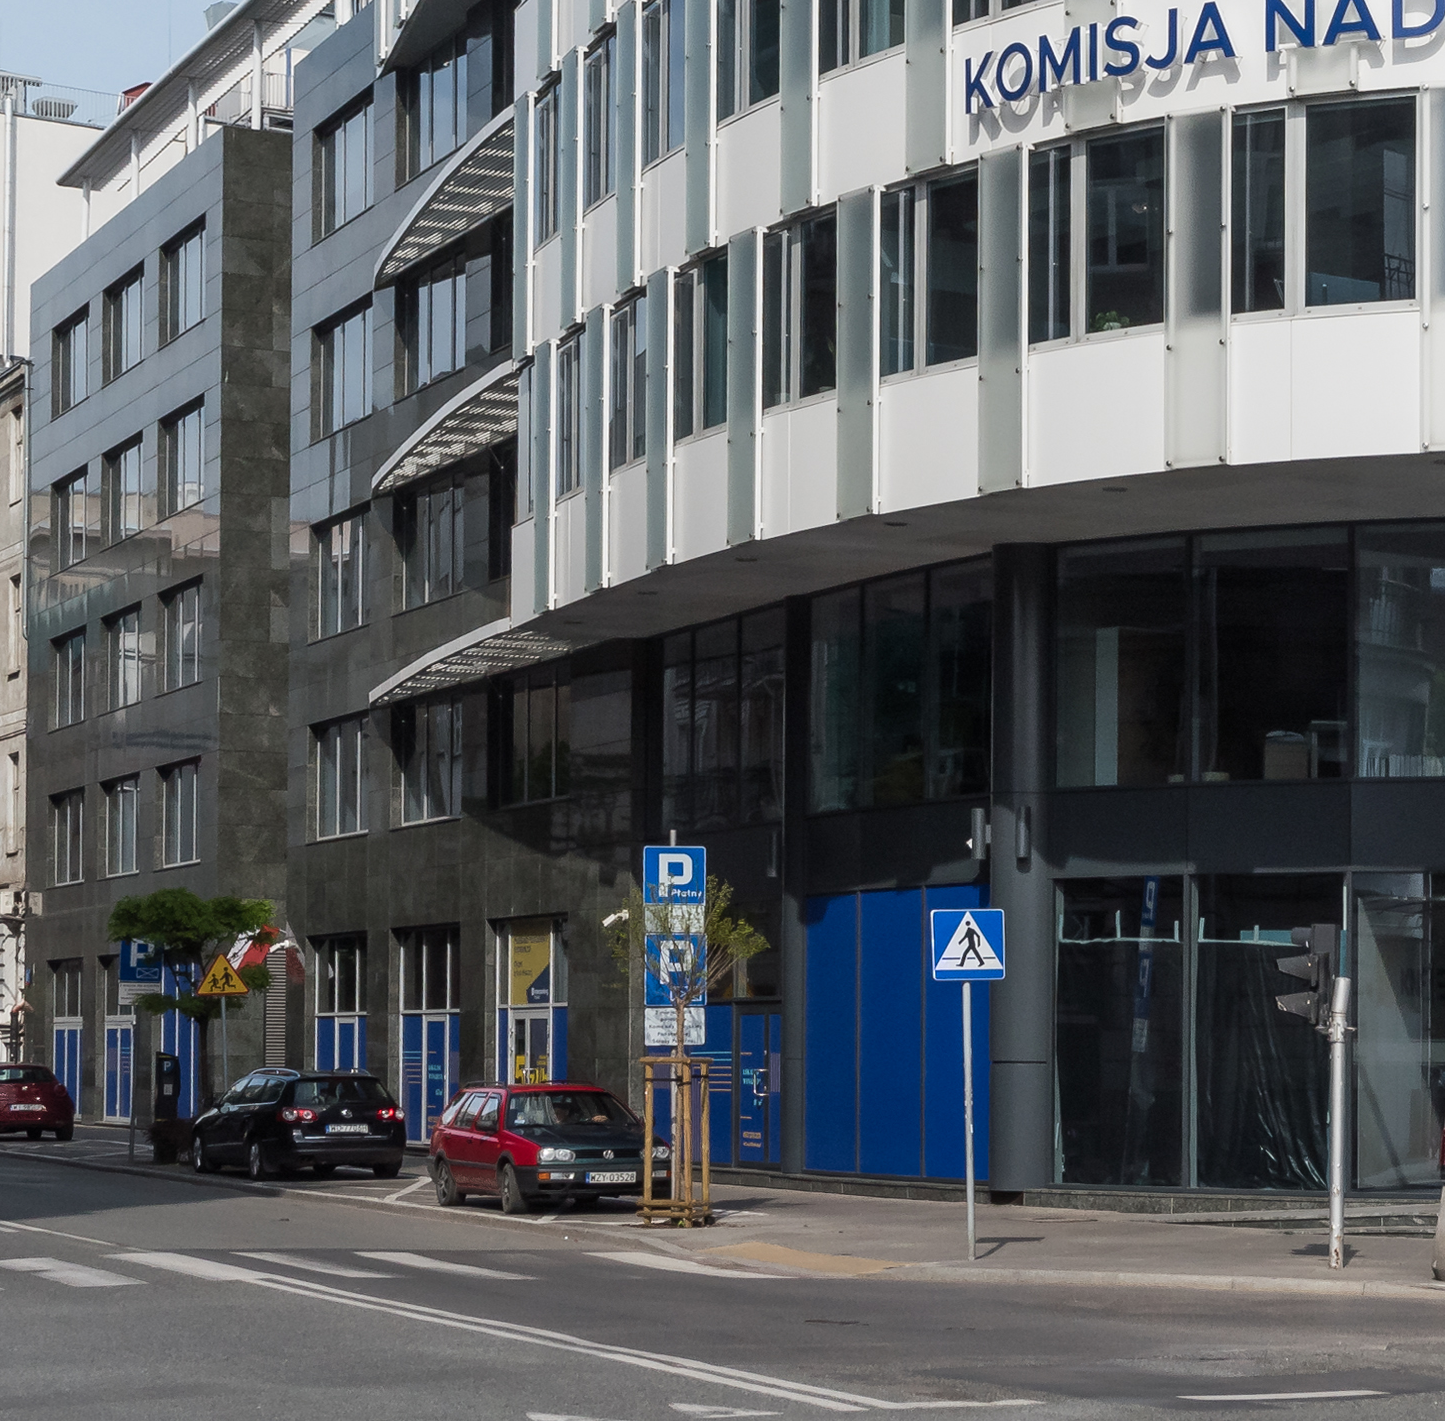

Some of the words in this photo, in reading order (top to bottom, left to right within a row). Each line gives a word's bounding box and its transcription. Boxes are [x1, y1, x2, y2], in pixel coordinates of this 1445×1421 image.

[964, 1, 1235, 114] KOMISJA
[658, 852, 693, 898] P
[590, 1172, 606, 1182] WZY
[609, 1172, 636, 1182] 03528
